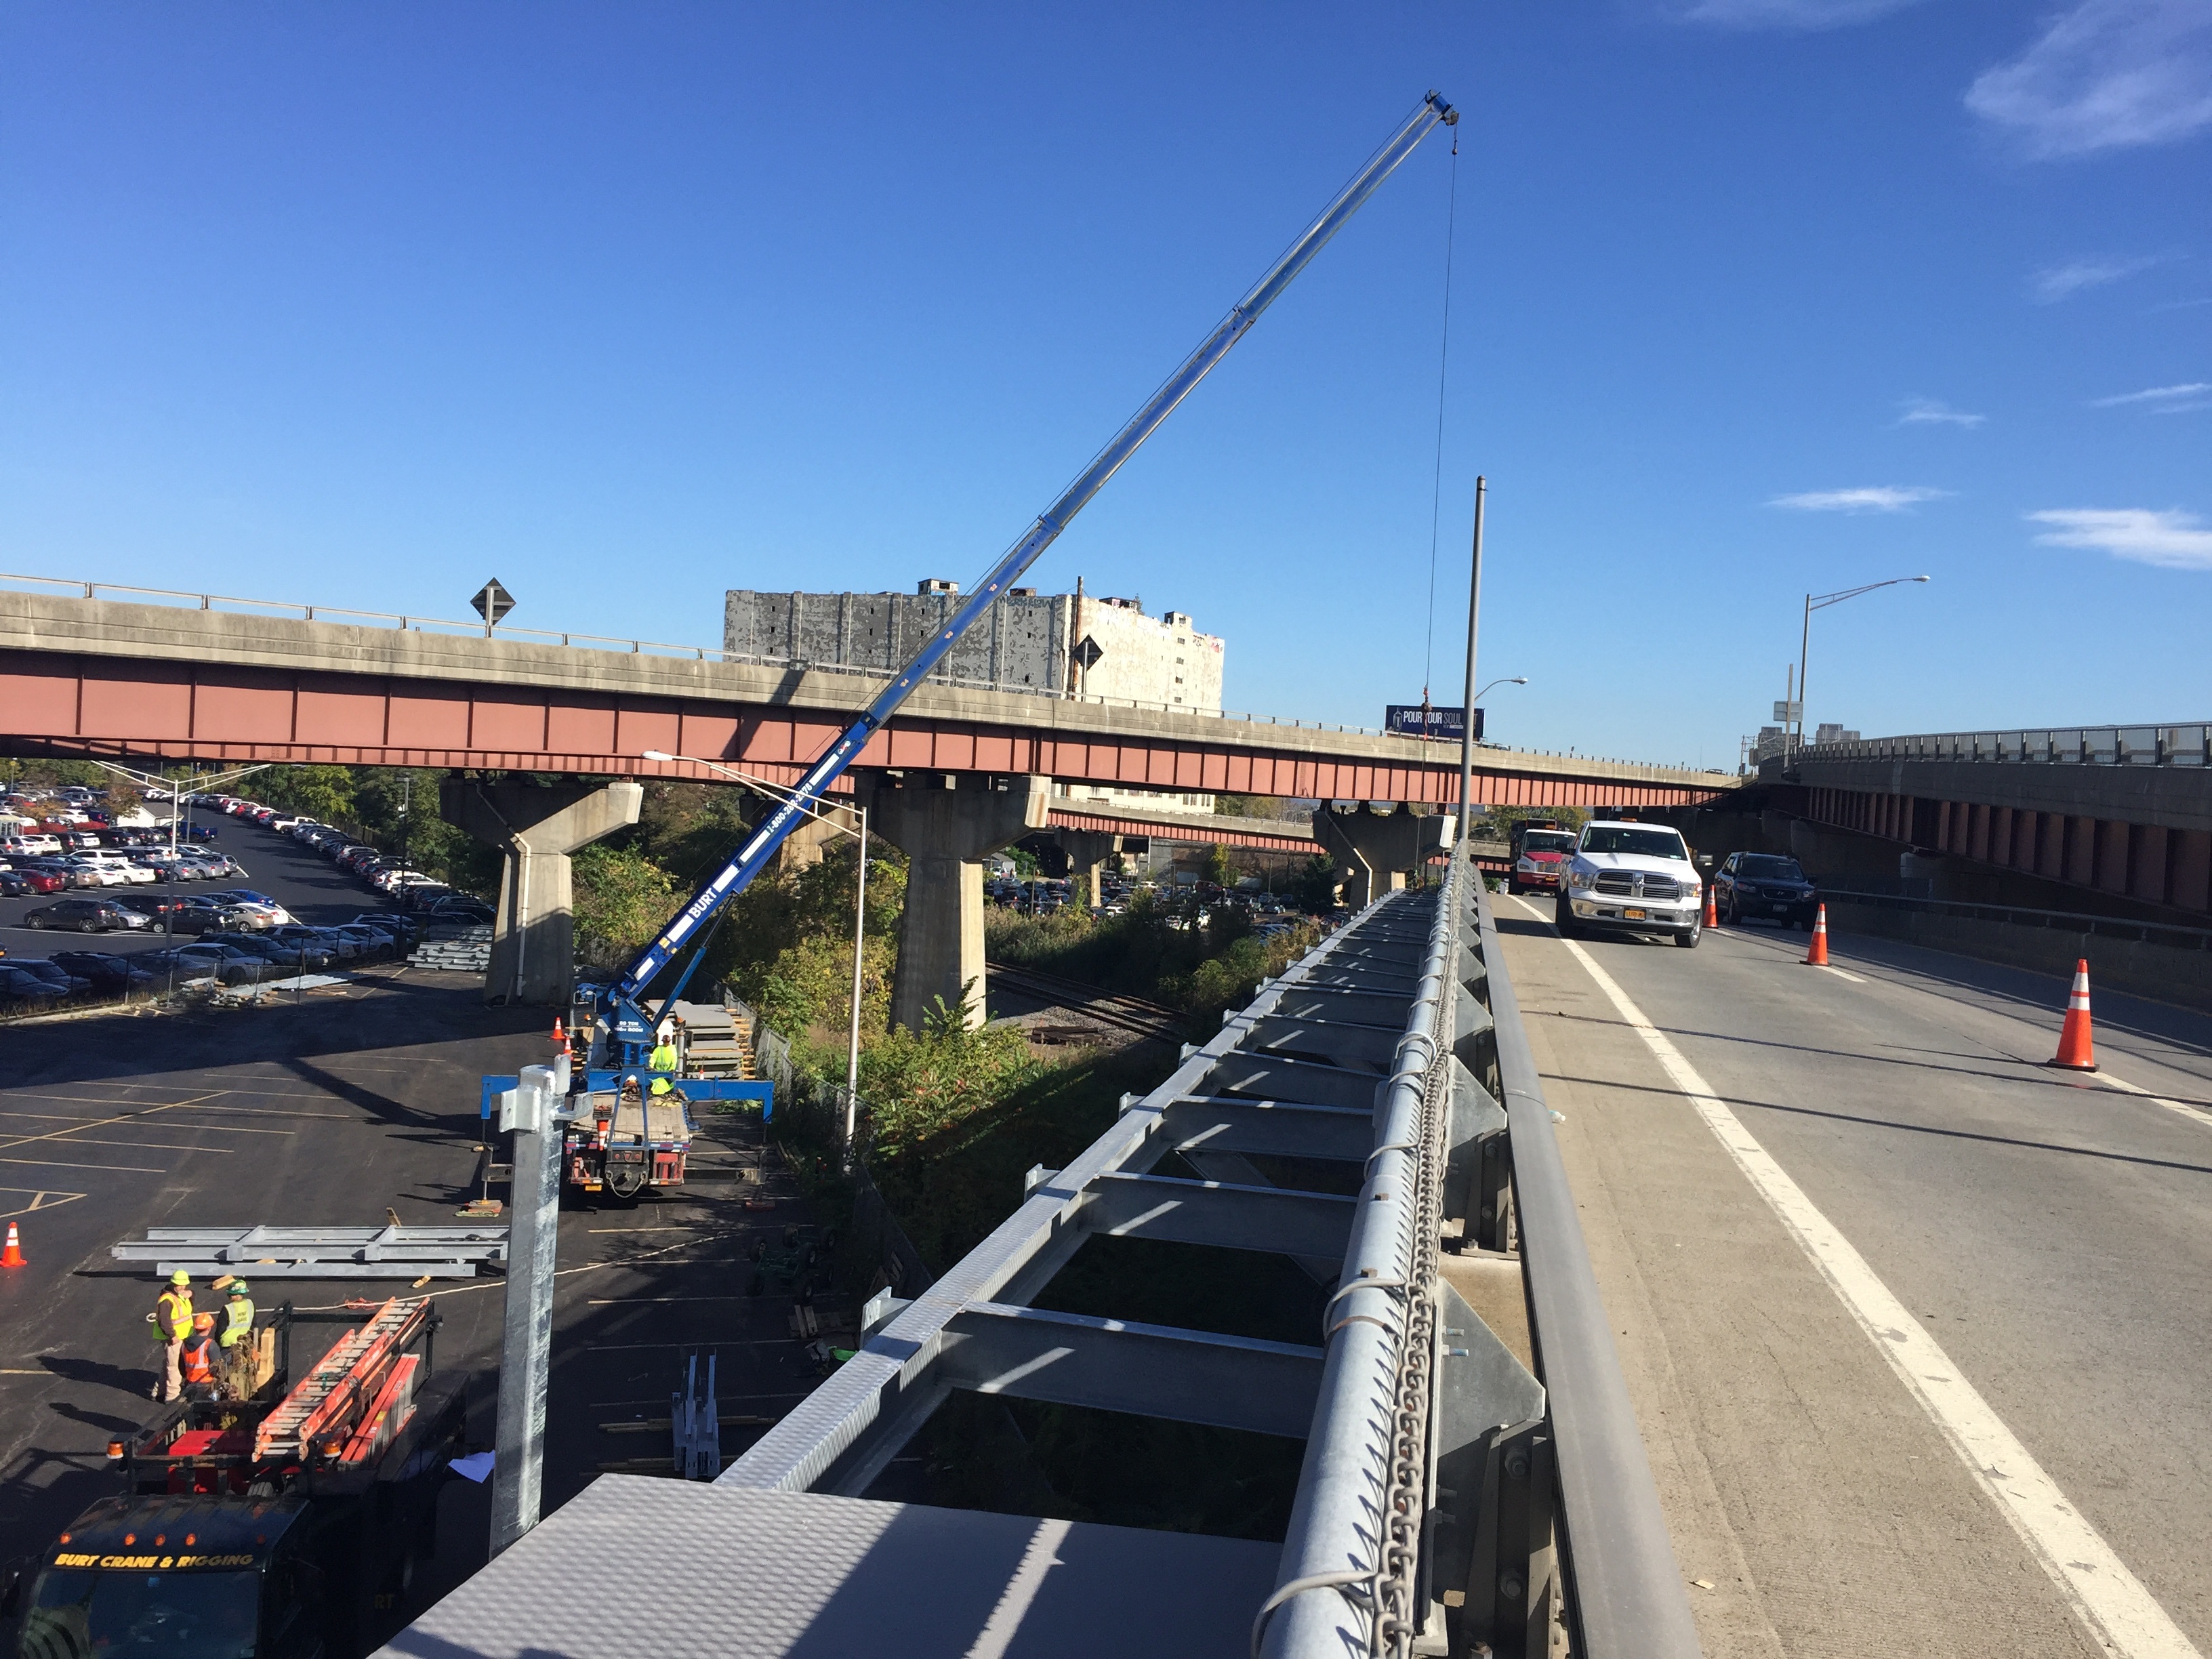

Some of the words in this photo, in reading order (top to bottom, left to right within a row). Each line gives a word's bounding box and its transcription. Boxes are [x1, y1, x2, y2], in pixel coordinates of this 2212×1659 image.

[1404, 711, 1422, 723] POUR
[1443, 712, 1462, 724] SOUL
[688, 887, 717, 918] BURT
[54, 1553, 100, 1568] BURT
[100, 1555, 158, 1568] CRANE
[159, 1555, 174, 1568] &
[176, 1554, 254, 1568] RIGGING
